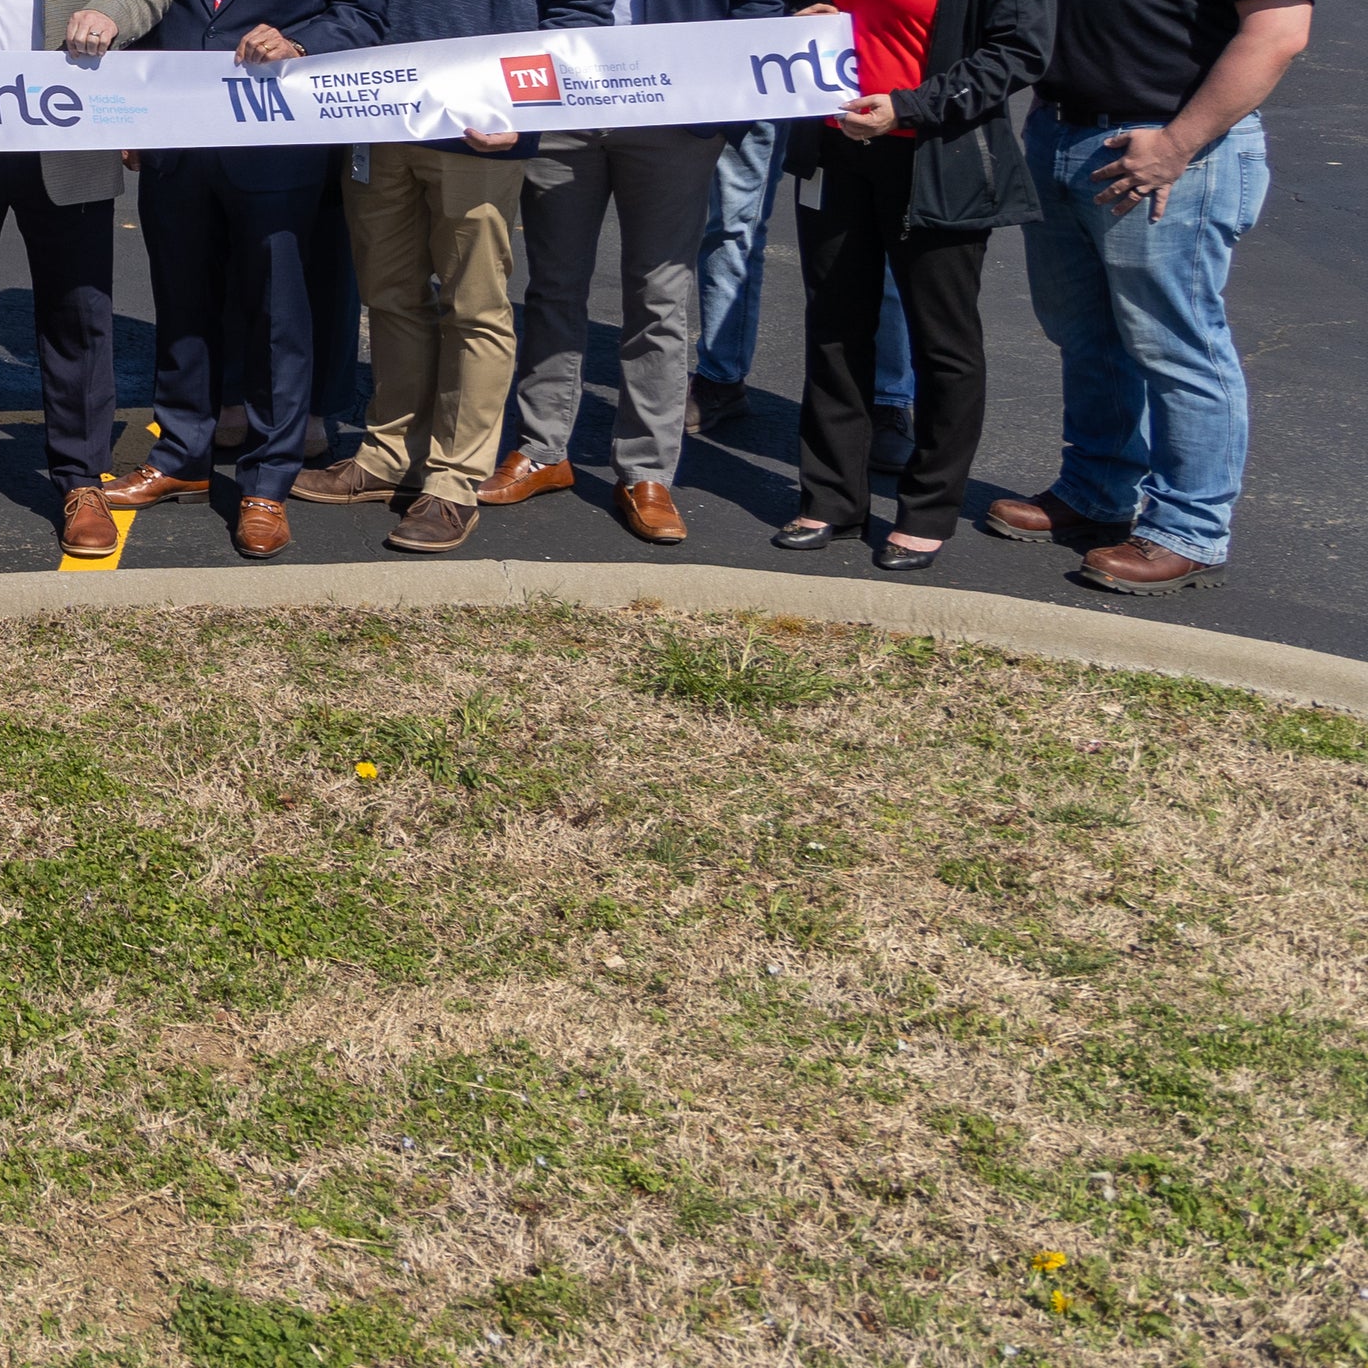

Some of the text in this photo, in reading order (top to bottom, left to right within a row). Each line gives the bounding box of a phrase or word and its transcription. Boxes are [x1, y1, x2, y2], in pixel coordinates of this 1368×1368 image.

[559, 60, 640, 75] Department of
[310, 68, 418, 89] TENNESSEE
[510, 68, 549, 89] TN
[563, 73, 672, 90] Environment &
[88, 95, 126, 104] Middle
[222, 78, 295, 122] TVA
[312, 88, 380, 104] VALLEY
[566, 91, 664, 106] Conservation
[91, 104, 148, 114] Tennessee
[320, 100, 422, 119] AUTHORITY
[92, 114, 134, 124] Electric
